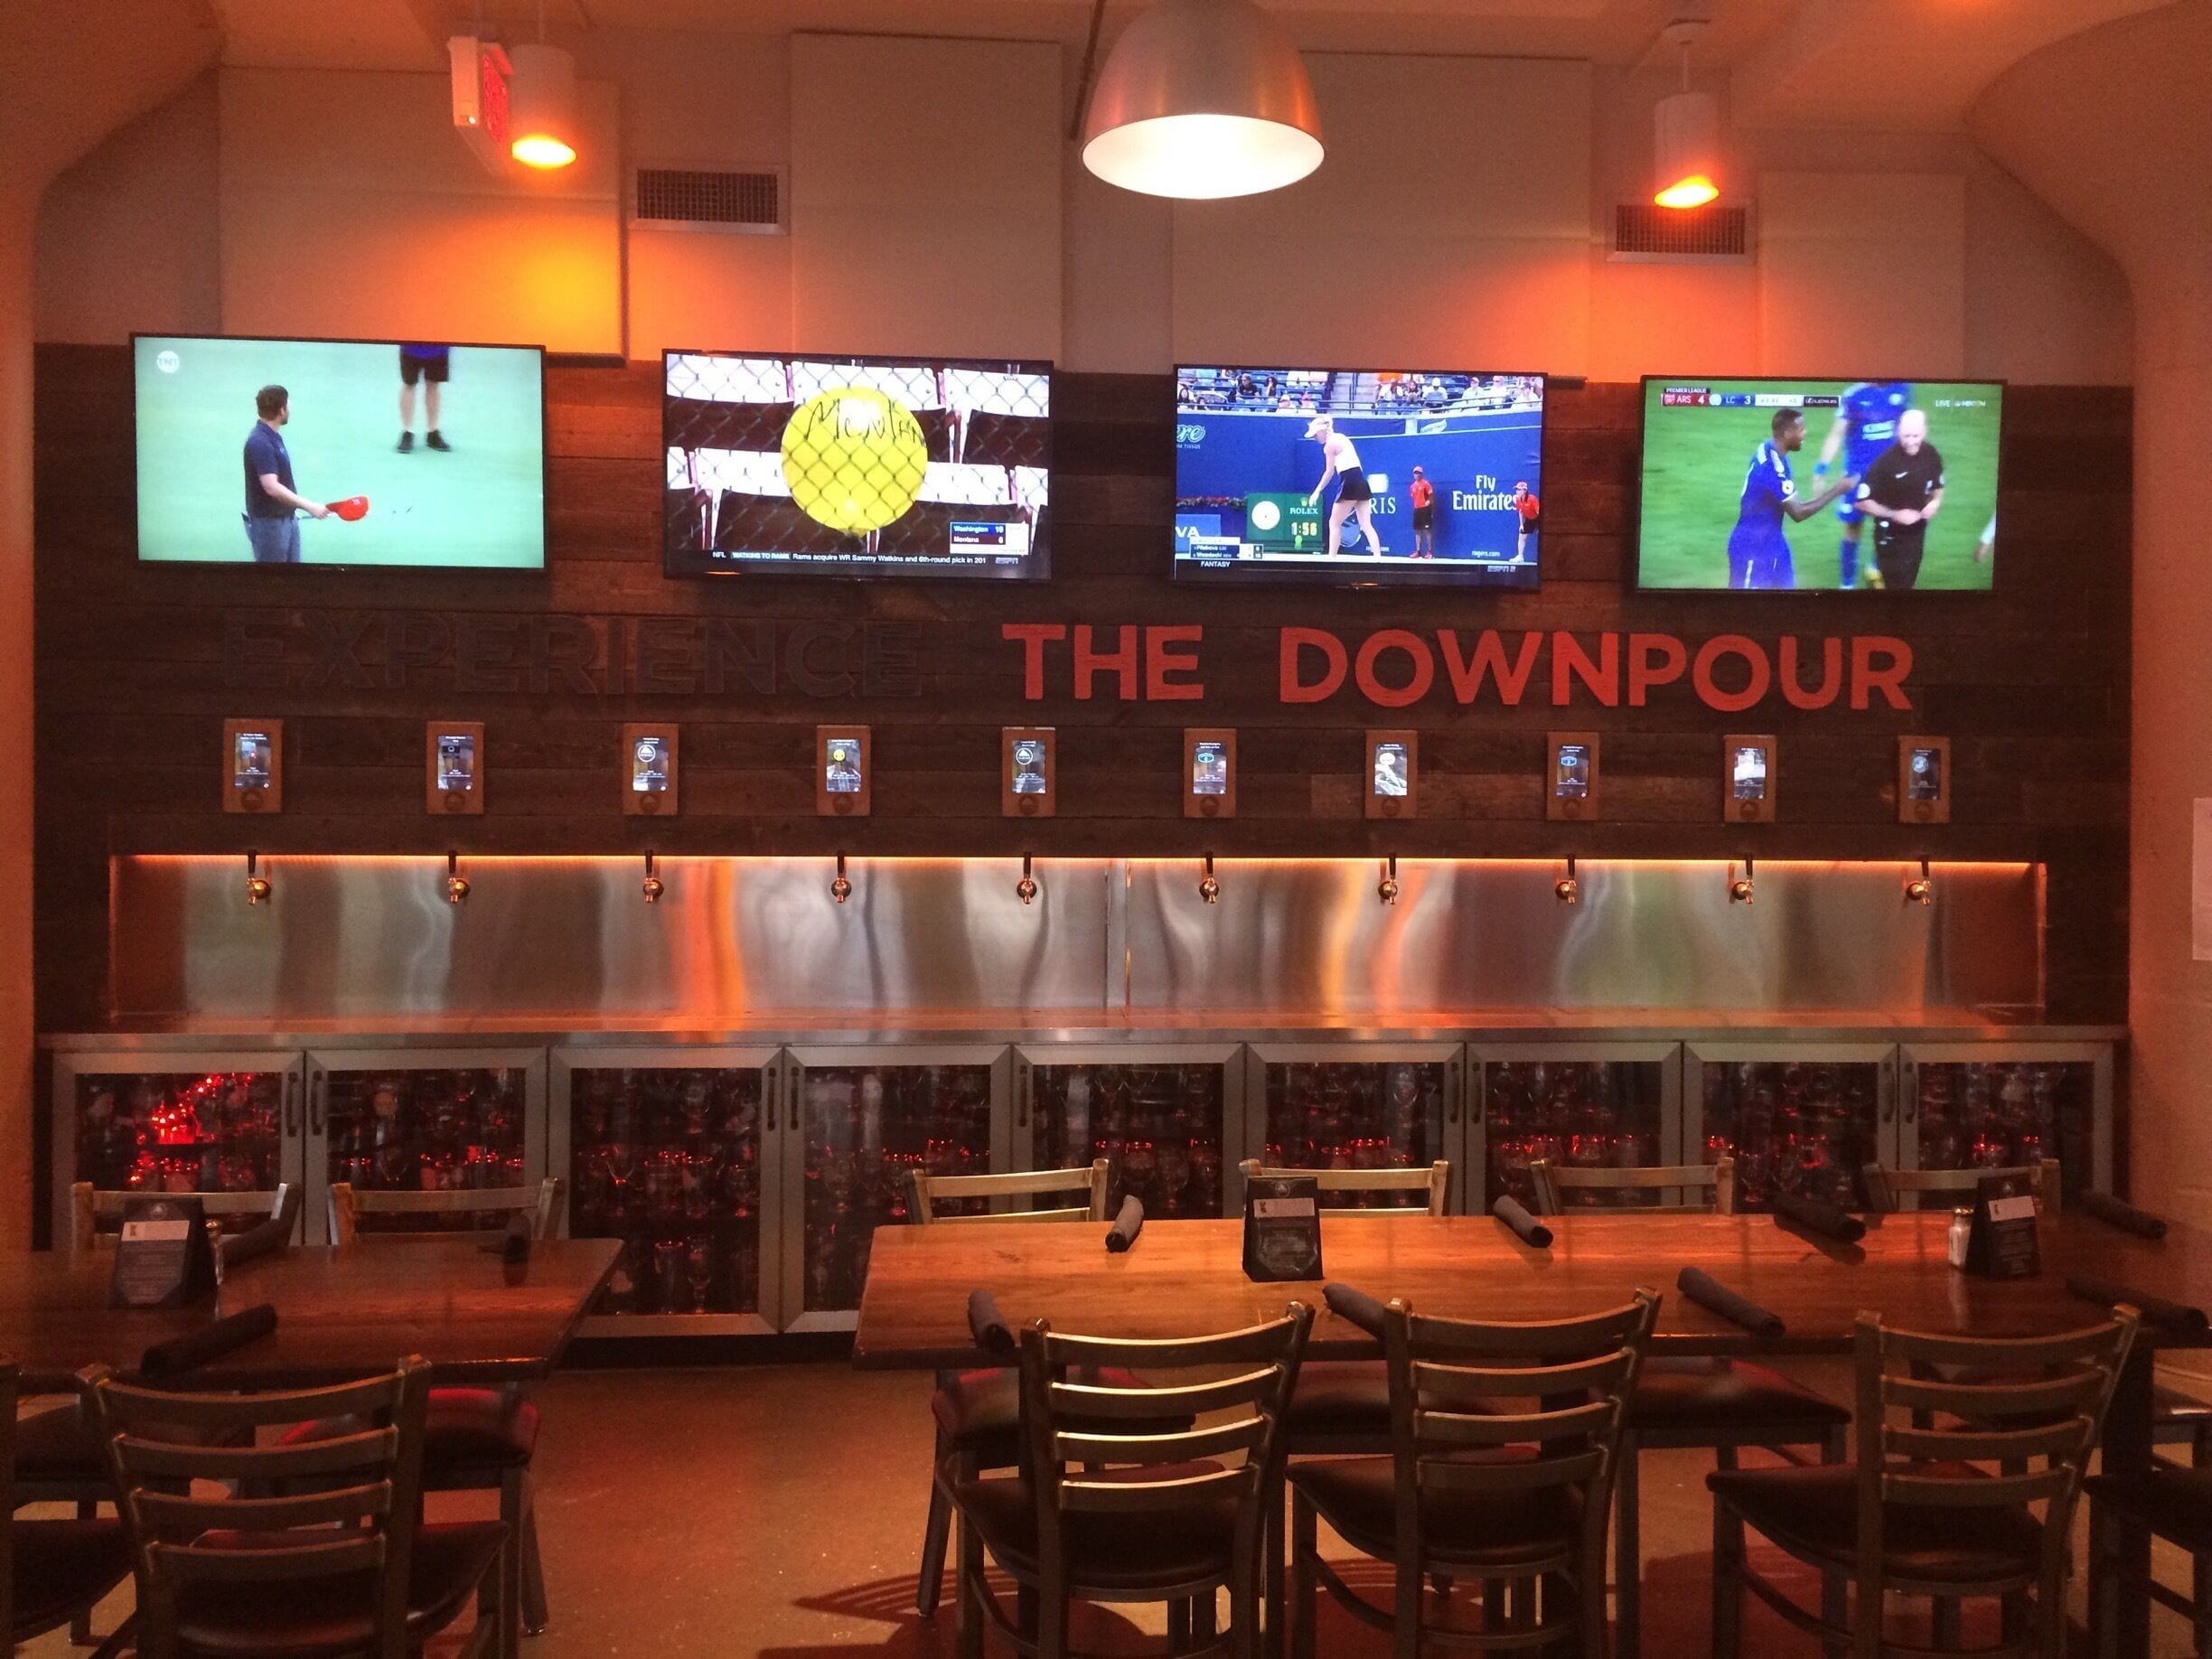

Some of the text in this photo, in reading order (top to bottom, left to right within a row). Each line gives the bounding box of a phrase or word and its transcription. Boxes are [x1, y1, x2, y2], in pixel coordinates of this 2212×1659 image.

[1676, 395, 1692, 404] ARS
[1698, 395, 1705, 405] 4
[1726, 396, 1736, 404] LC
[1744, 396, 1751, 405] 3
[1476, 474, 1496, 492] Fly
[1289, 507, 1318, 515] ROLEX
[812, 554, 839, 562] acquire
[852, 555, 876, 563] Sammy
[918, 556, 951, 564] 6th-round
[951, 557, 966, 565] pick
[995, 557, 1019, 565] ESPN
[224, 610, 1913, 711] EXPERIENCE THE DOWNPOUR
